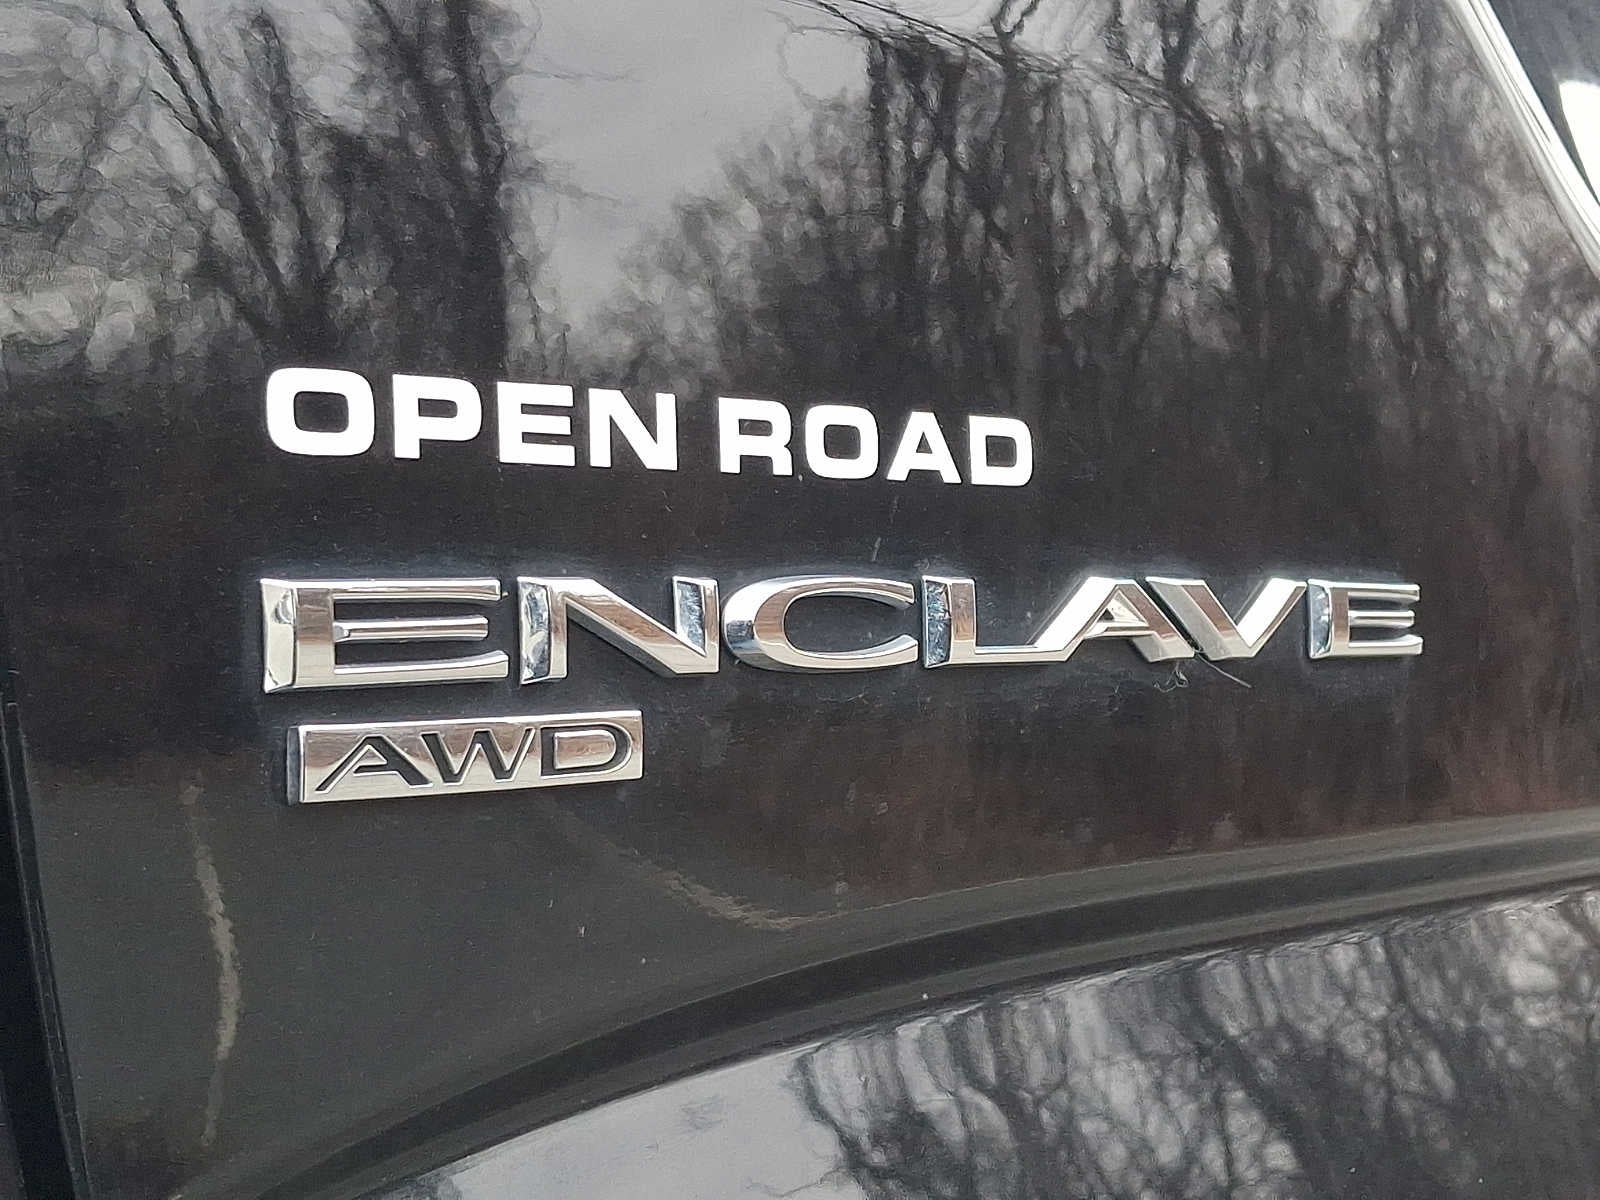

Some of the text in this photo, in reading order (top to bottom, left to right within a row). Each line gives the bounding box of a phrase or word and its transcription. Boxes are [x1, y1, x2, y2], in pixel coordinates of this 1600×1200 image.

[266, 367, 1034, 487] OPEN ROAD
[260, 575, 1423, 693] ENCLAVE
[316, 723, 633, 792] AWD
